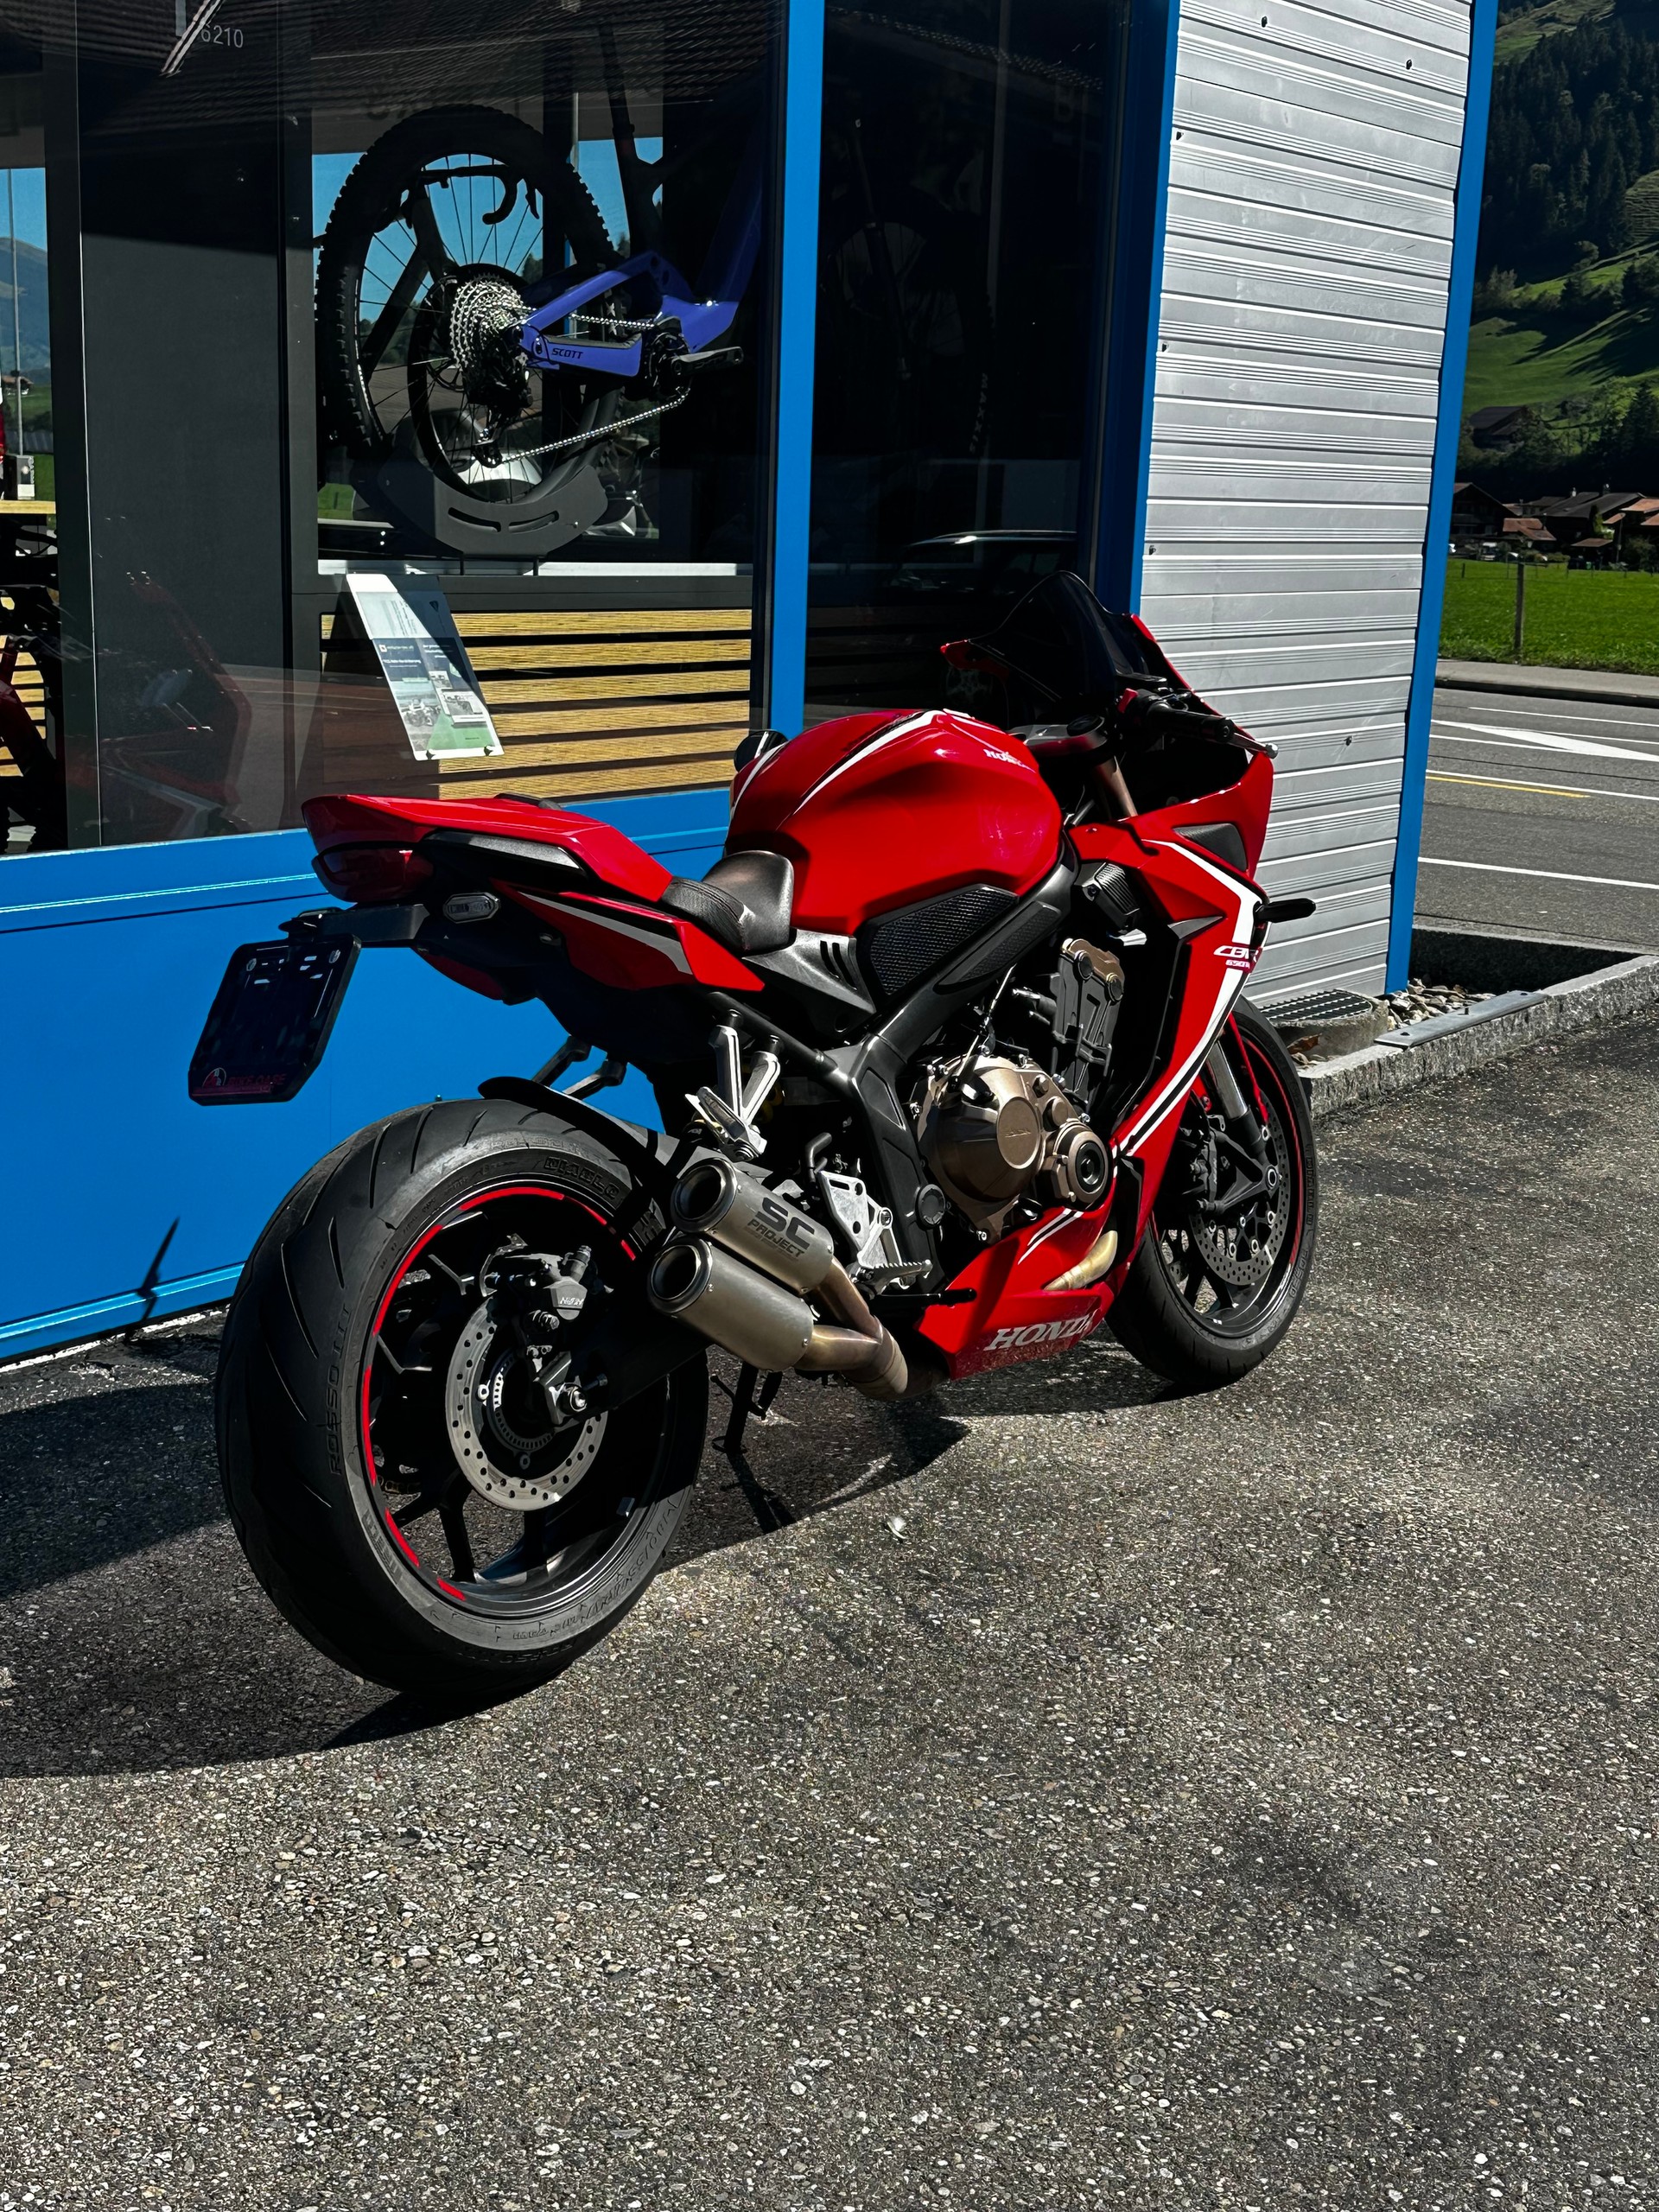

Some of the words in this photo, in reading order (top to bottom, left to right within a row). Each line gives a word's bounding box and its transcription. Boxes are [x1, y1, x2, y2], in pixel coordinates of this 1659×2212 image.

[200, 22, 244, 48] 6210
[551, 347, 584, 359] SCOTT
[544, 1156, 620, 1199] DIABLO
[747, 1218, 805, 1257] PROJECT
[755, 1197, 815, 1250] SC
[982, 1311, 1096, 1351] HONDA
[326, 1364, 342, 1476] ROSSO
